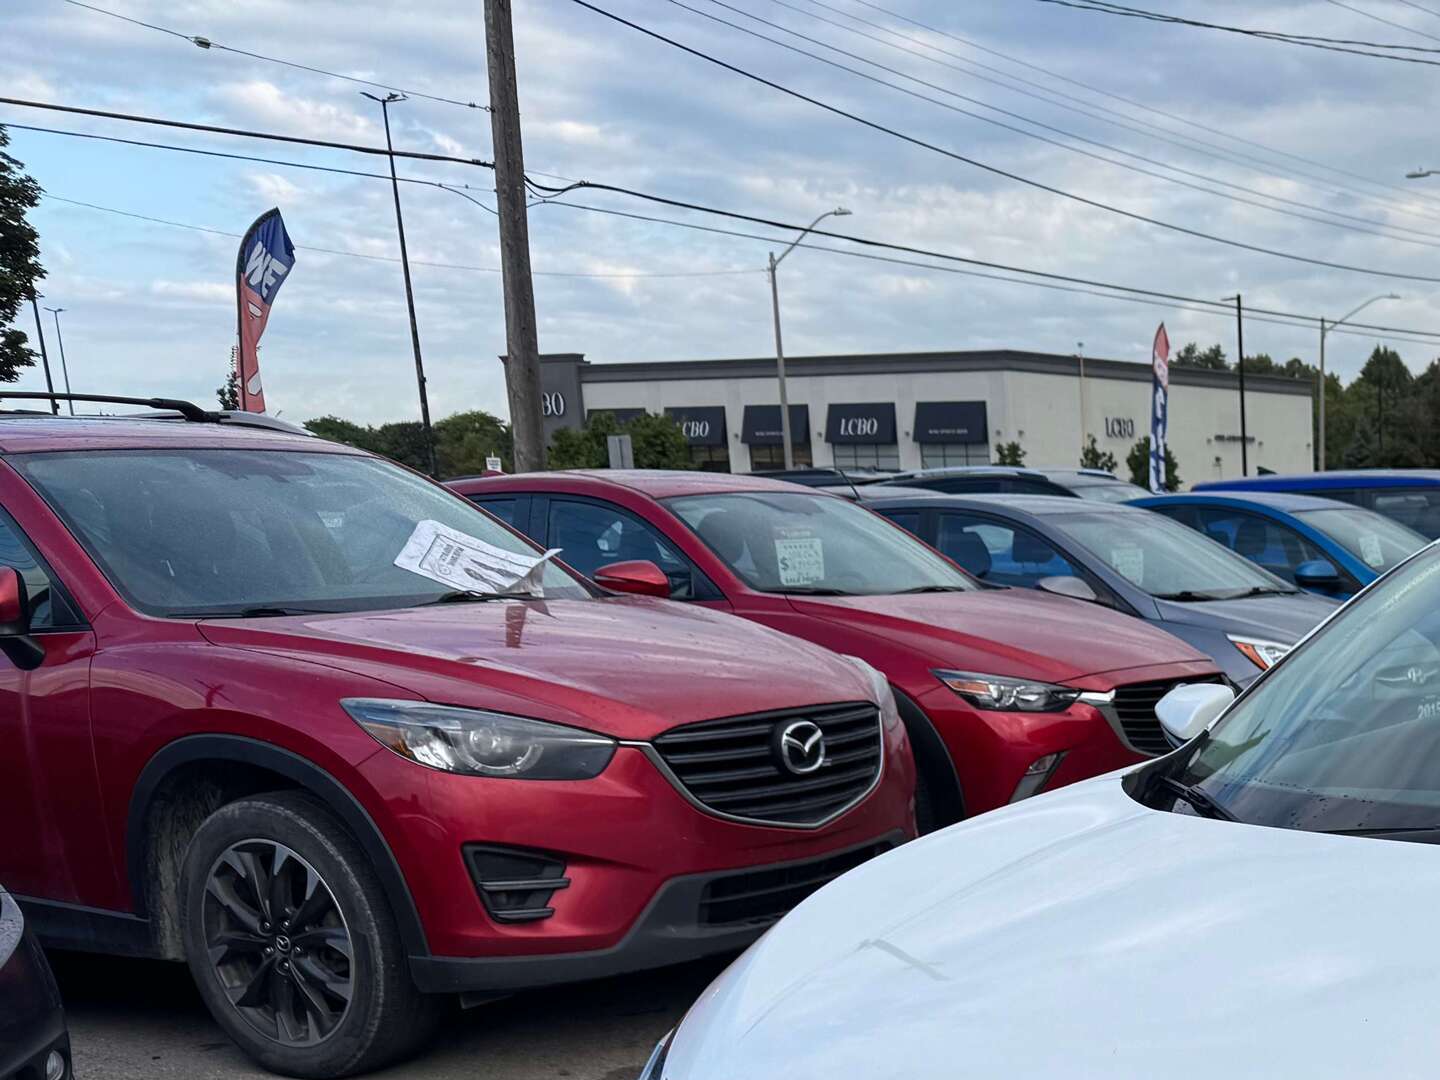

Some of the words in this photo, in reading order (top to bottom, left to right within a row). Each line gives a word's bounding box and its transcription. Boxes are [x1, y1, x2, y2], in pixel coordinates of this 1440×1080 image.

[681, 421, 710, 438] CBO
[840, 417, 878, 436] LCBO
[1105, 416, 1135, 438] LCBO
